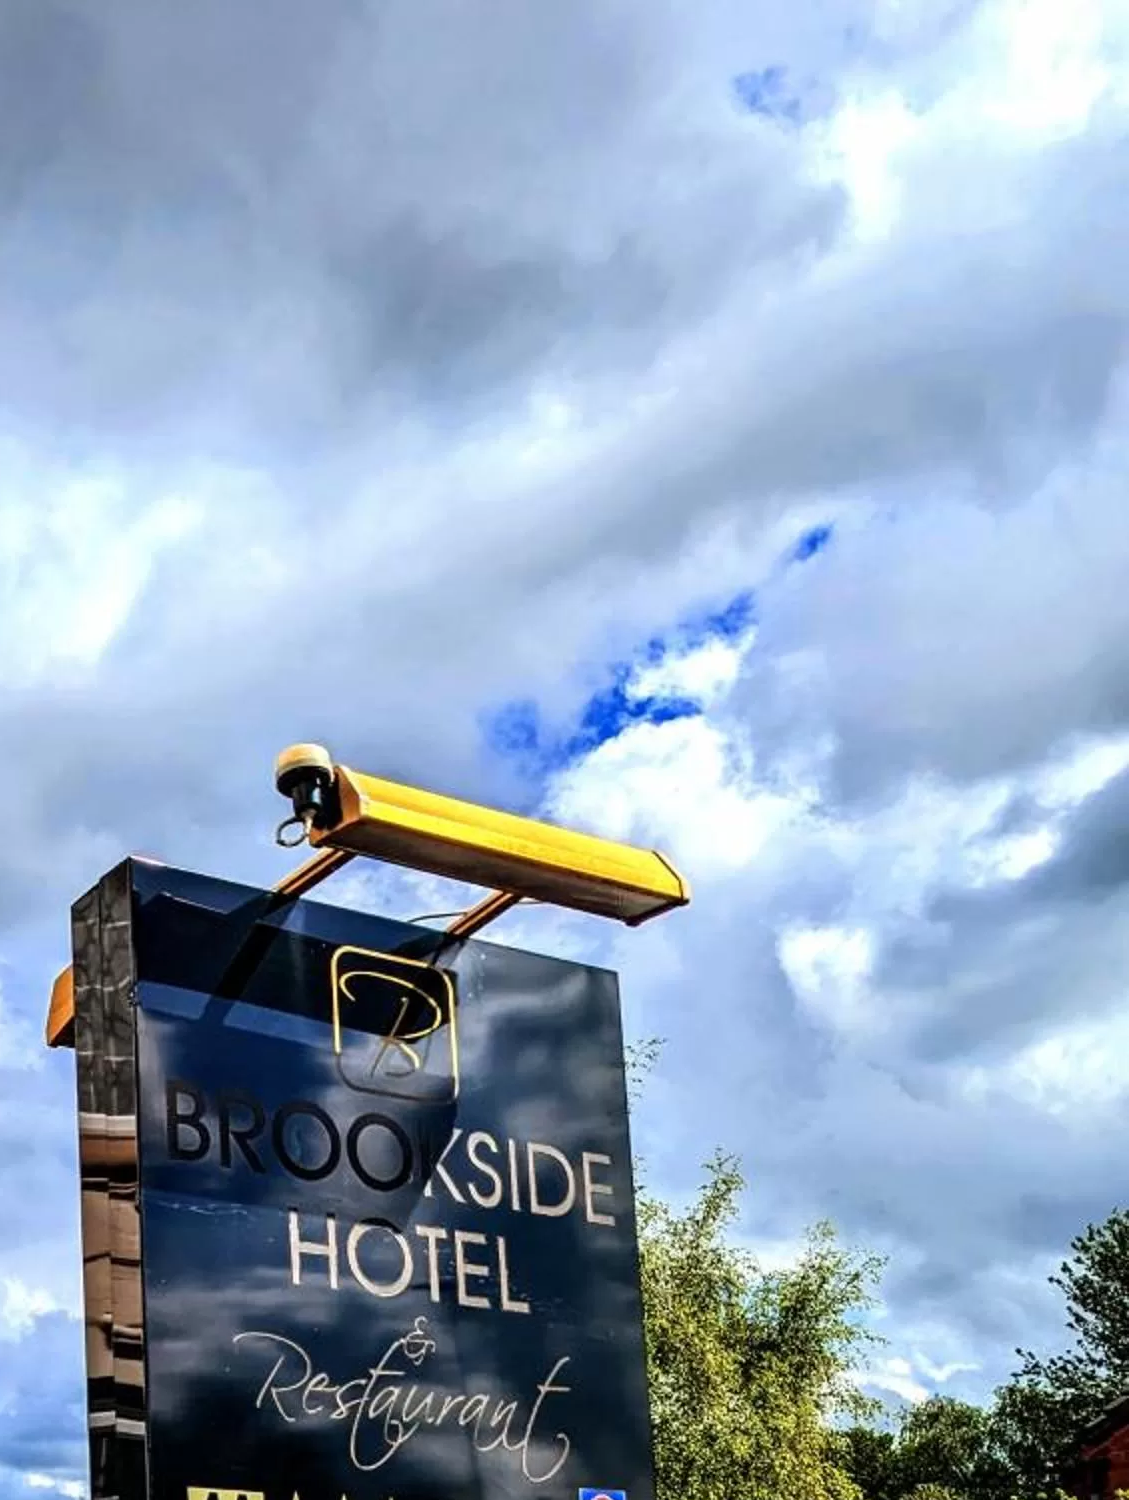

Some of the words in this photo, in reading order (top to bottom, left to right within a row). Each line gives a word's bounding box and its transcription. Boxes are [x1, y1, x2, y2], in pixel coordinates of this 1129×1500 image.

[164, 1080, 617, 1227] BROOKSIDE
[288, 1206, 531, 1314] HOTEL
[400, 1316, 436, 1365] &
[232, 1331, 571, 1483] Restaurant
